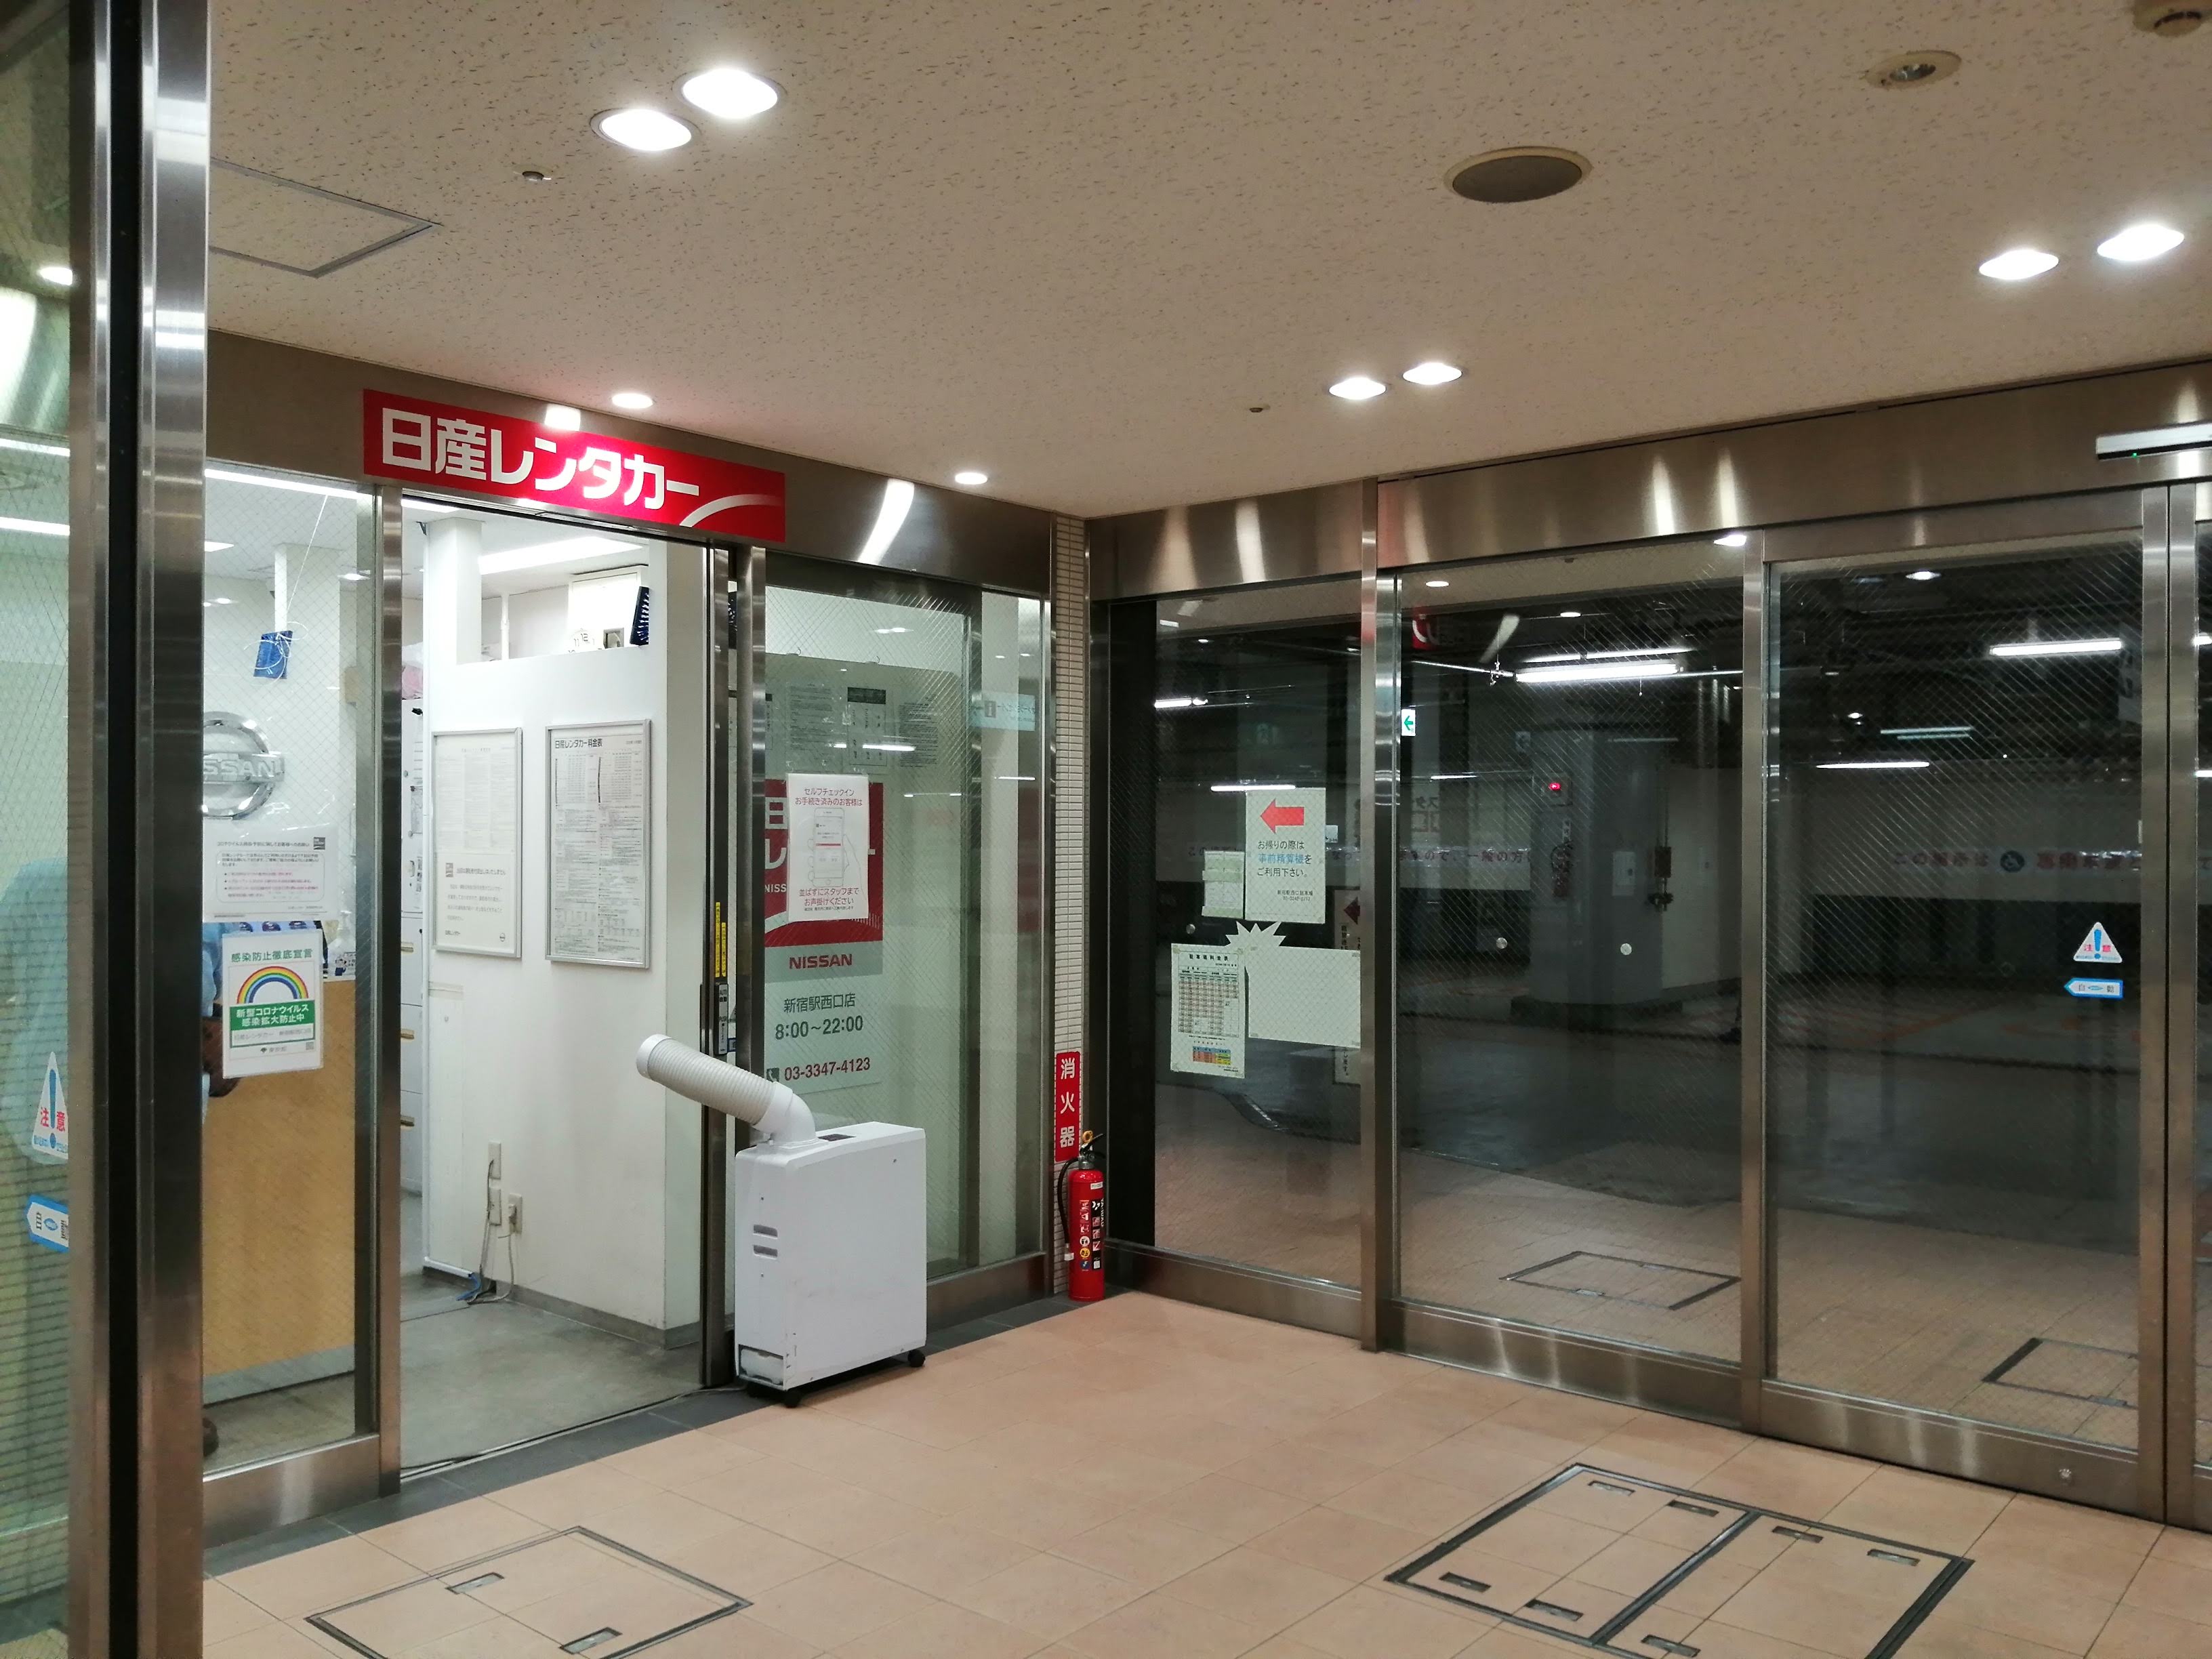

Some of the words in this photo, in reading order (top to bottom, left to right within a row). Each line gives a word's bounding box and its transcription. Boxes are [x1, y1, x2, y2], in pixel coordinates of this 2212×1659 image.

[382, 407, 699, 510] 日産レンタカー
[555, 738, 602, 749] 日産レンタカー料金表
[203, 758, 275, 777] SSAN
[804, 787, 855, 796] セルフチェックイン
[795, 798, 863, 806] お手続き済みのお客様は
[1257, 840, 1305, 850] お帰りの際は
[1258, 853, 1311, 865] 事前精算機を
[764, 882, 787, 893] NISS
[799, 887, 859, 897] 並ばずにスタッフまで
[804, 897, 854, 907] お声掛けください
[231, 949, 312, 962] 感染防止徹底宣言
[789, 954, 853, 969] NISSAN
[783, 993, 855, 1013] 新宿駅西口店
[237, 1004, 309, 1018] 新型コロナウイルス
[241, 1014, 305, 1027] 感染拡大防止中
[784, 1057, 870, 1081] 03-3347-4123
[1059, 1057, 1075, 1148] 消火器
